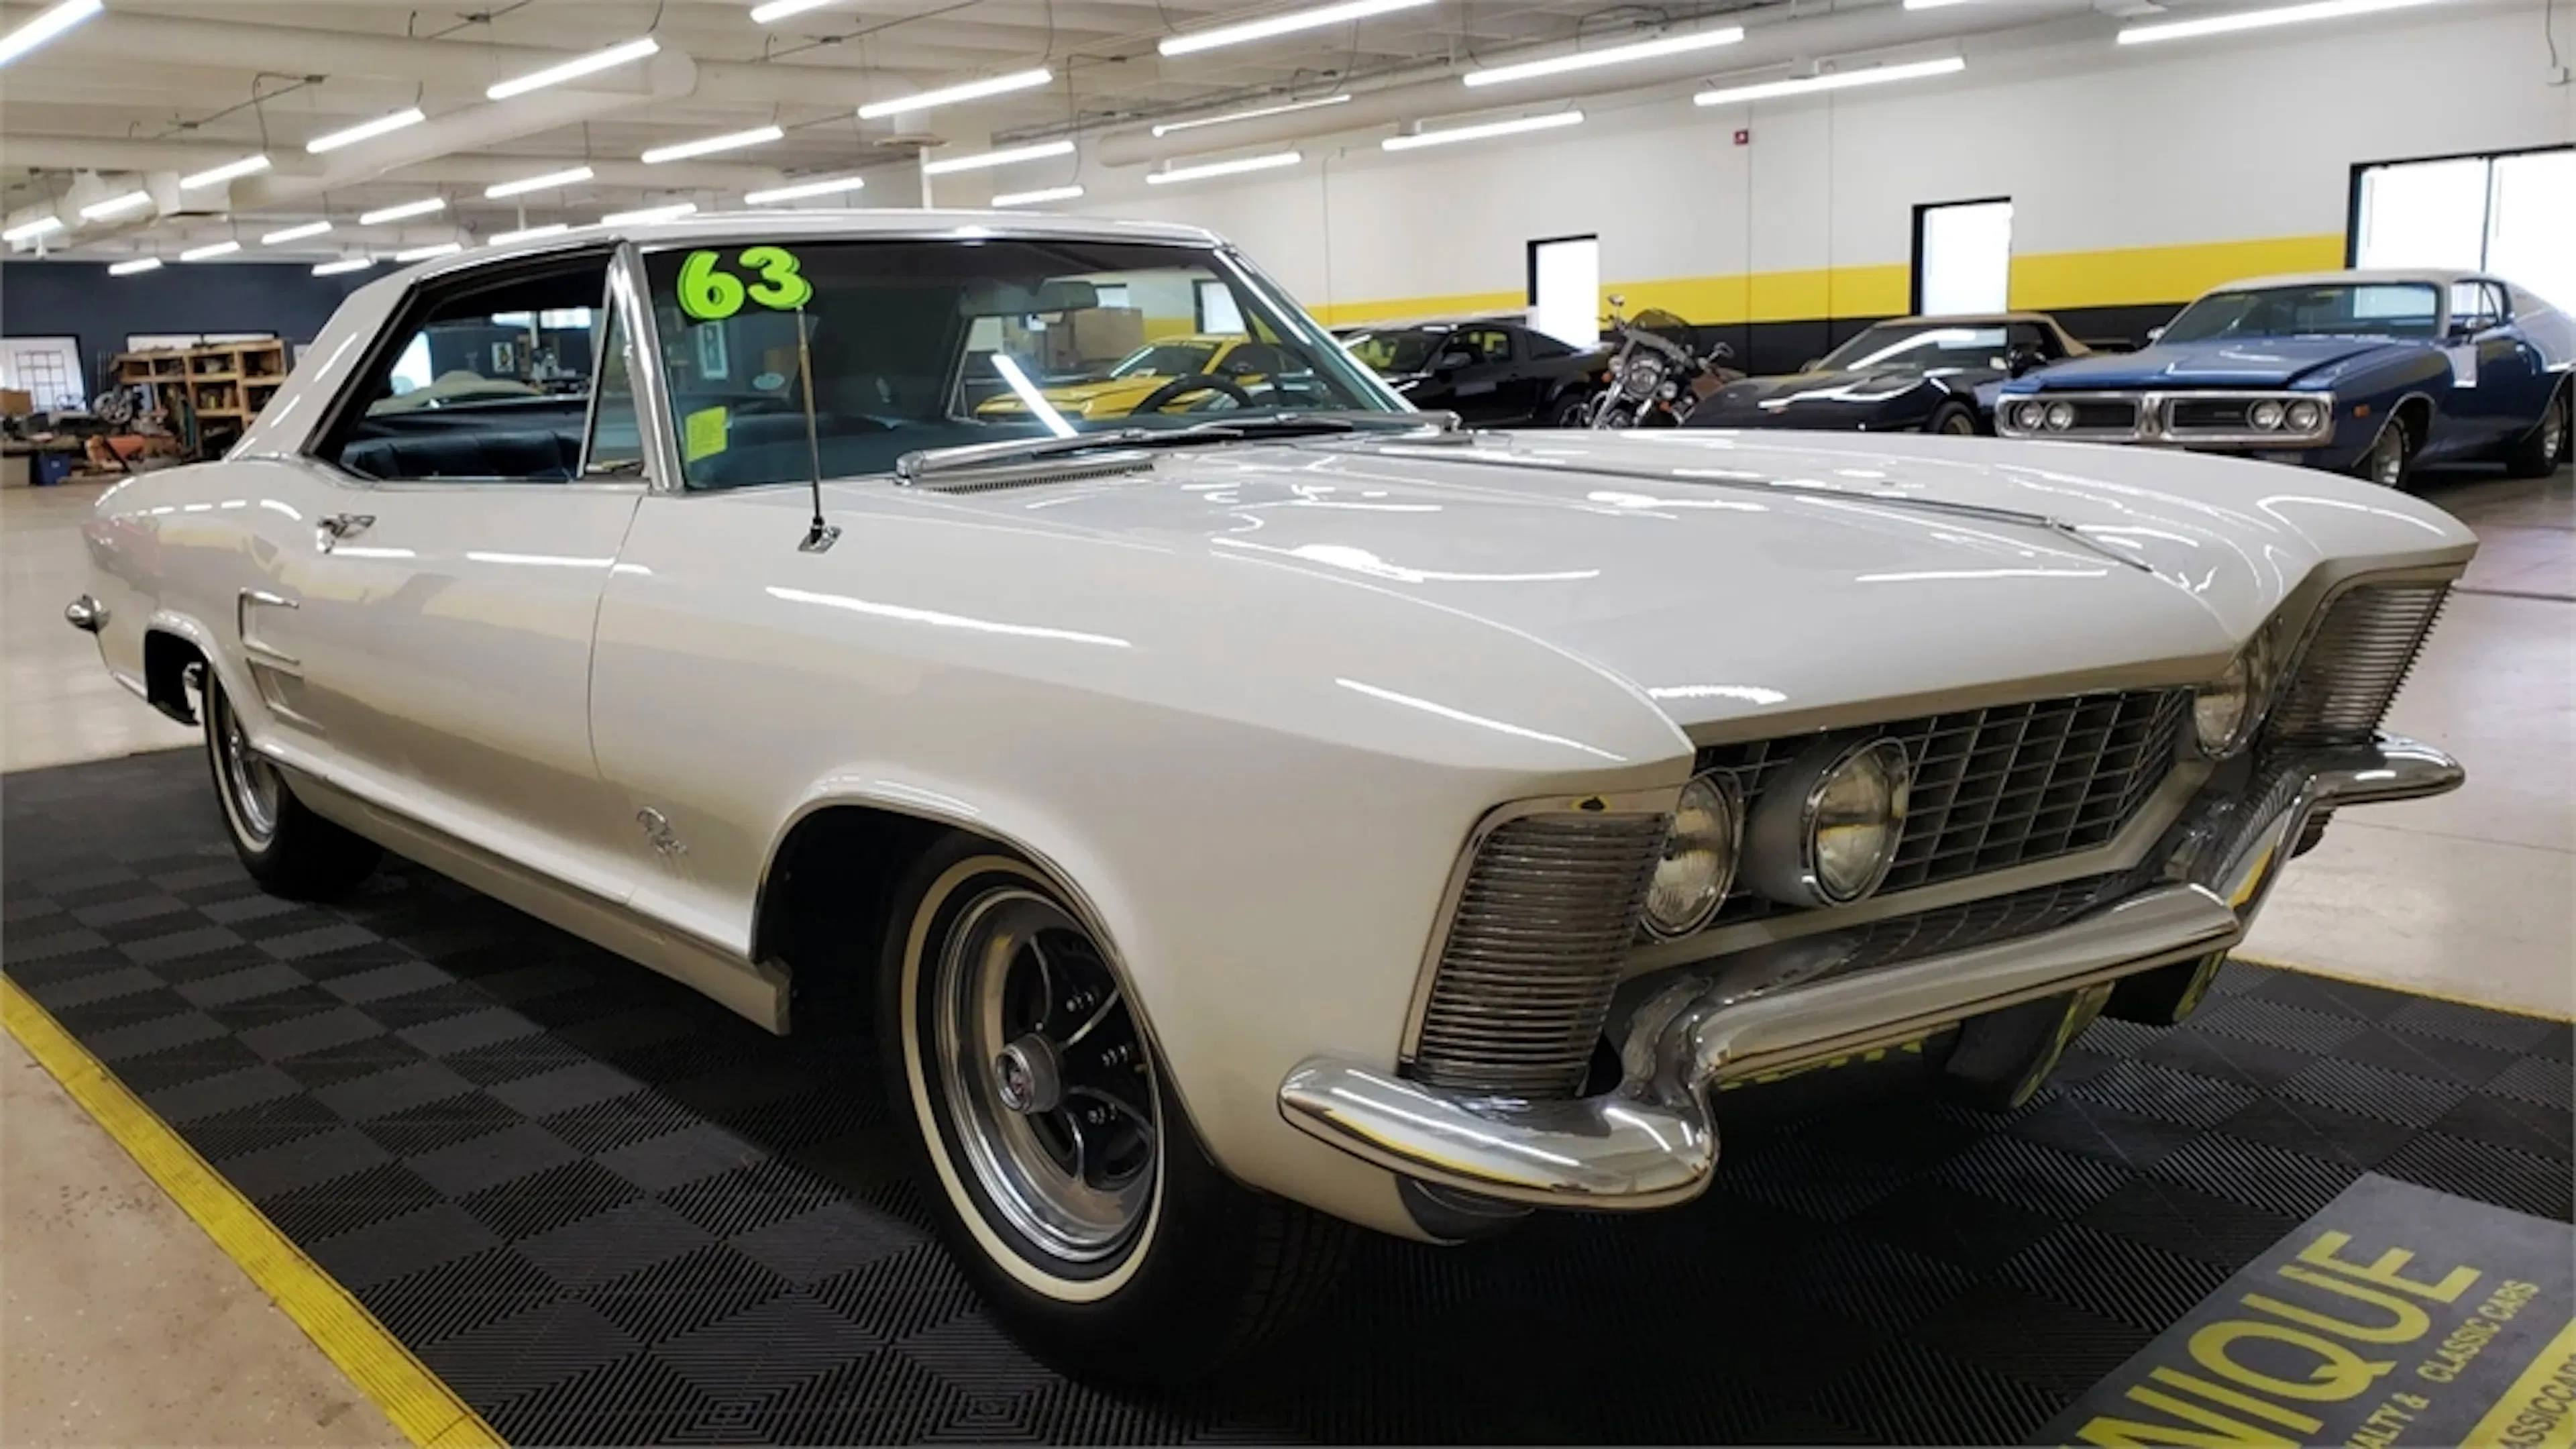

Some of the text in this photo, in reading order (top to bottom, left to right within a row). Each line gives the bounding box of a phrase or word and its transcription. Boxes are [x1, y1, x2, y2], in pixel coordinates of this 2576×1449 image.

[677, 246, 814, 319] 63
[2059, 1230, 2482, 1449] NIQUE
[2391, 1392, 2430, 1410] &
[2416, 1317, 2502, 1383] CLASSIC
[2477, 1279, 2540, 1321] CARS
